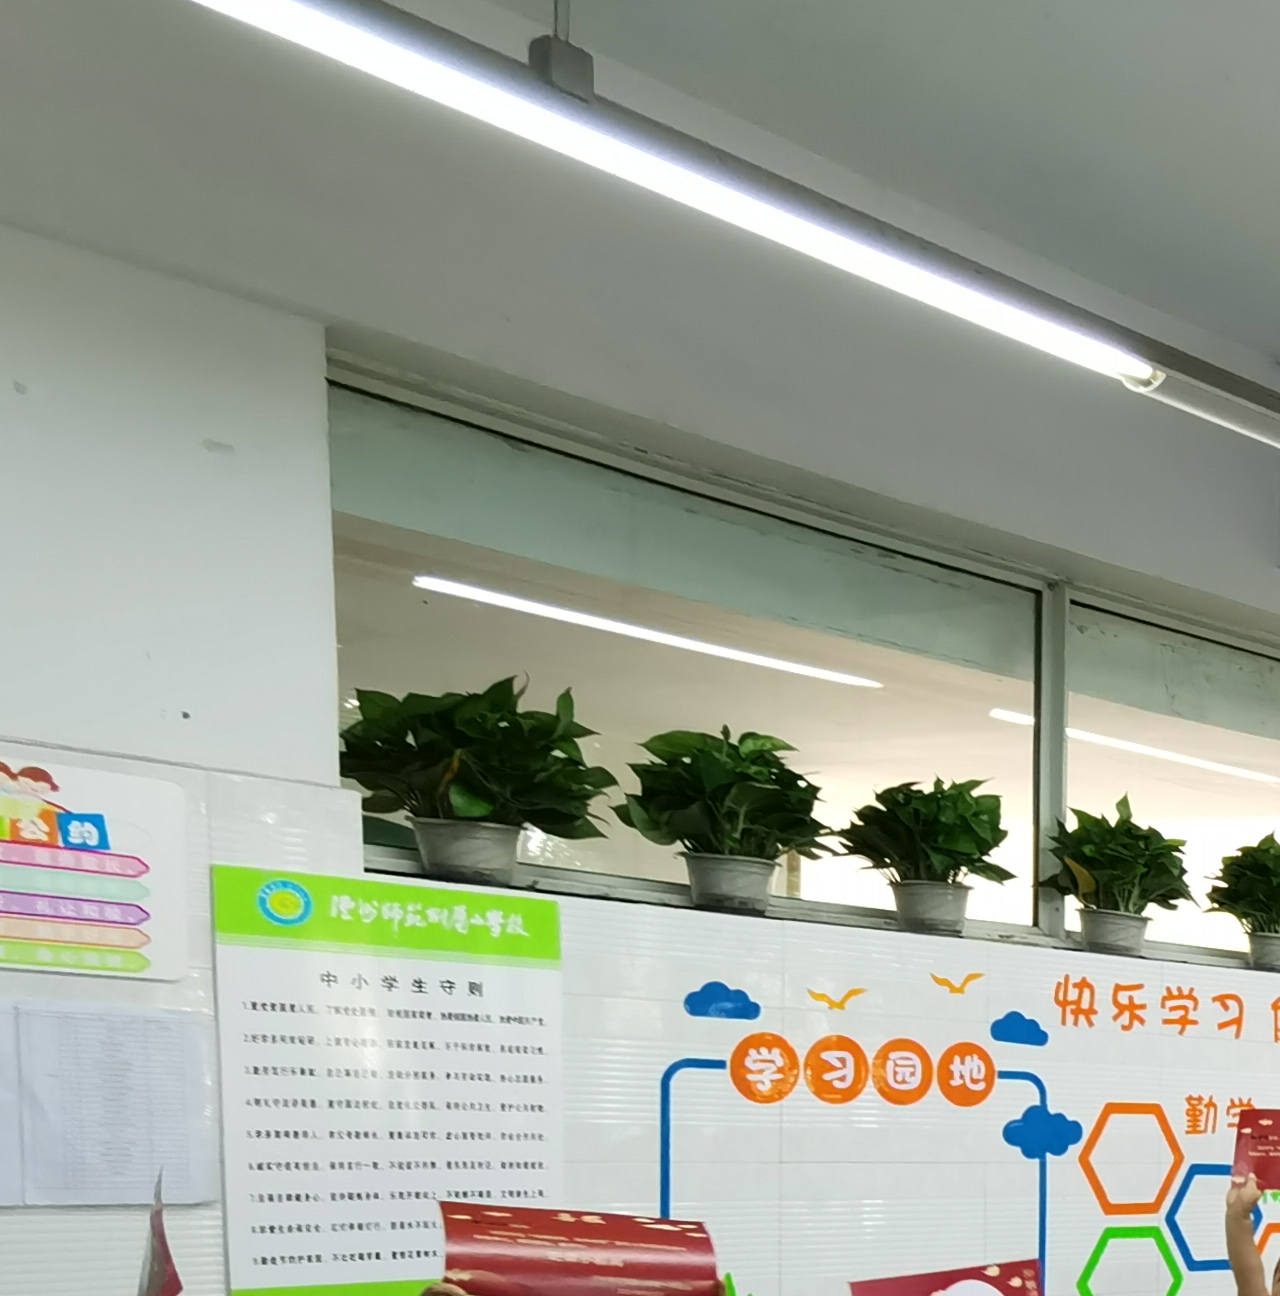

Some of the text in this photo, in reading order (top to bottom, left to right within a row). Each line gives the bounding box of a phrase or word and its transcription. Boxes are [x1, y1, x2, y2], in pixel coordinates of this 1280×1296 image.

[319, 970, 484, 998] 中小学生守则
[1054, 974, 1246, 1039] 快乐学习
[744, 1046, 987, 1093] 学习园地
